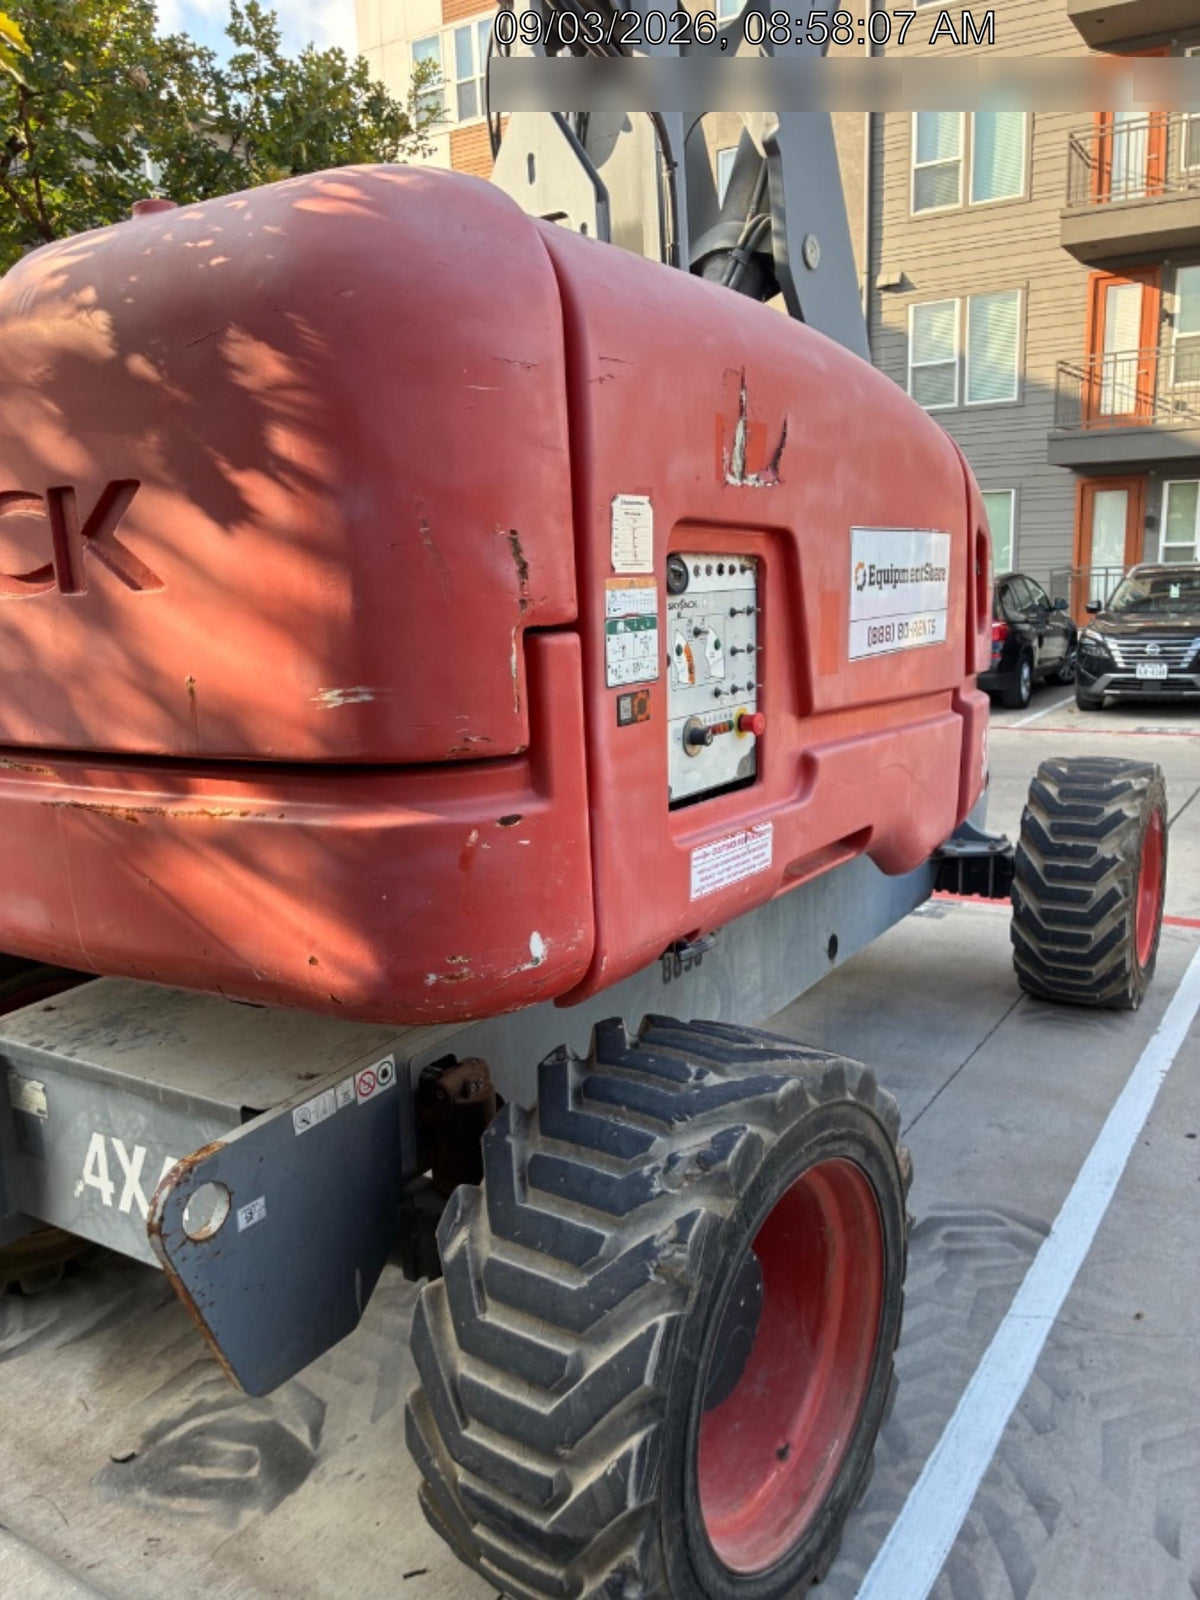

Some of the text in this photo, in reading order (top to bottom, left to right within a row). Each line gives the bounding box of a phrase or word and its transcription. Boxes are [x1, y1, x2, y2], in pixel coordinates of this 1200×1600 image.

[868, 563, 946, 590] EquipmentShare
[867, 623, 895, 647] (888)
[74, 1132, 179, 1221] 4X
